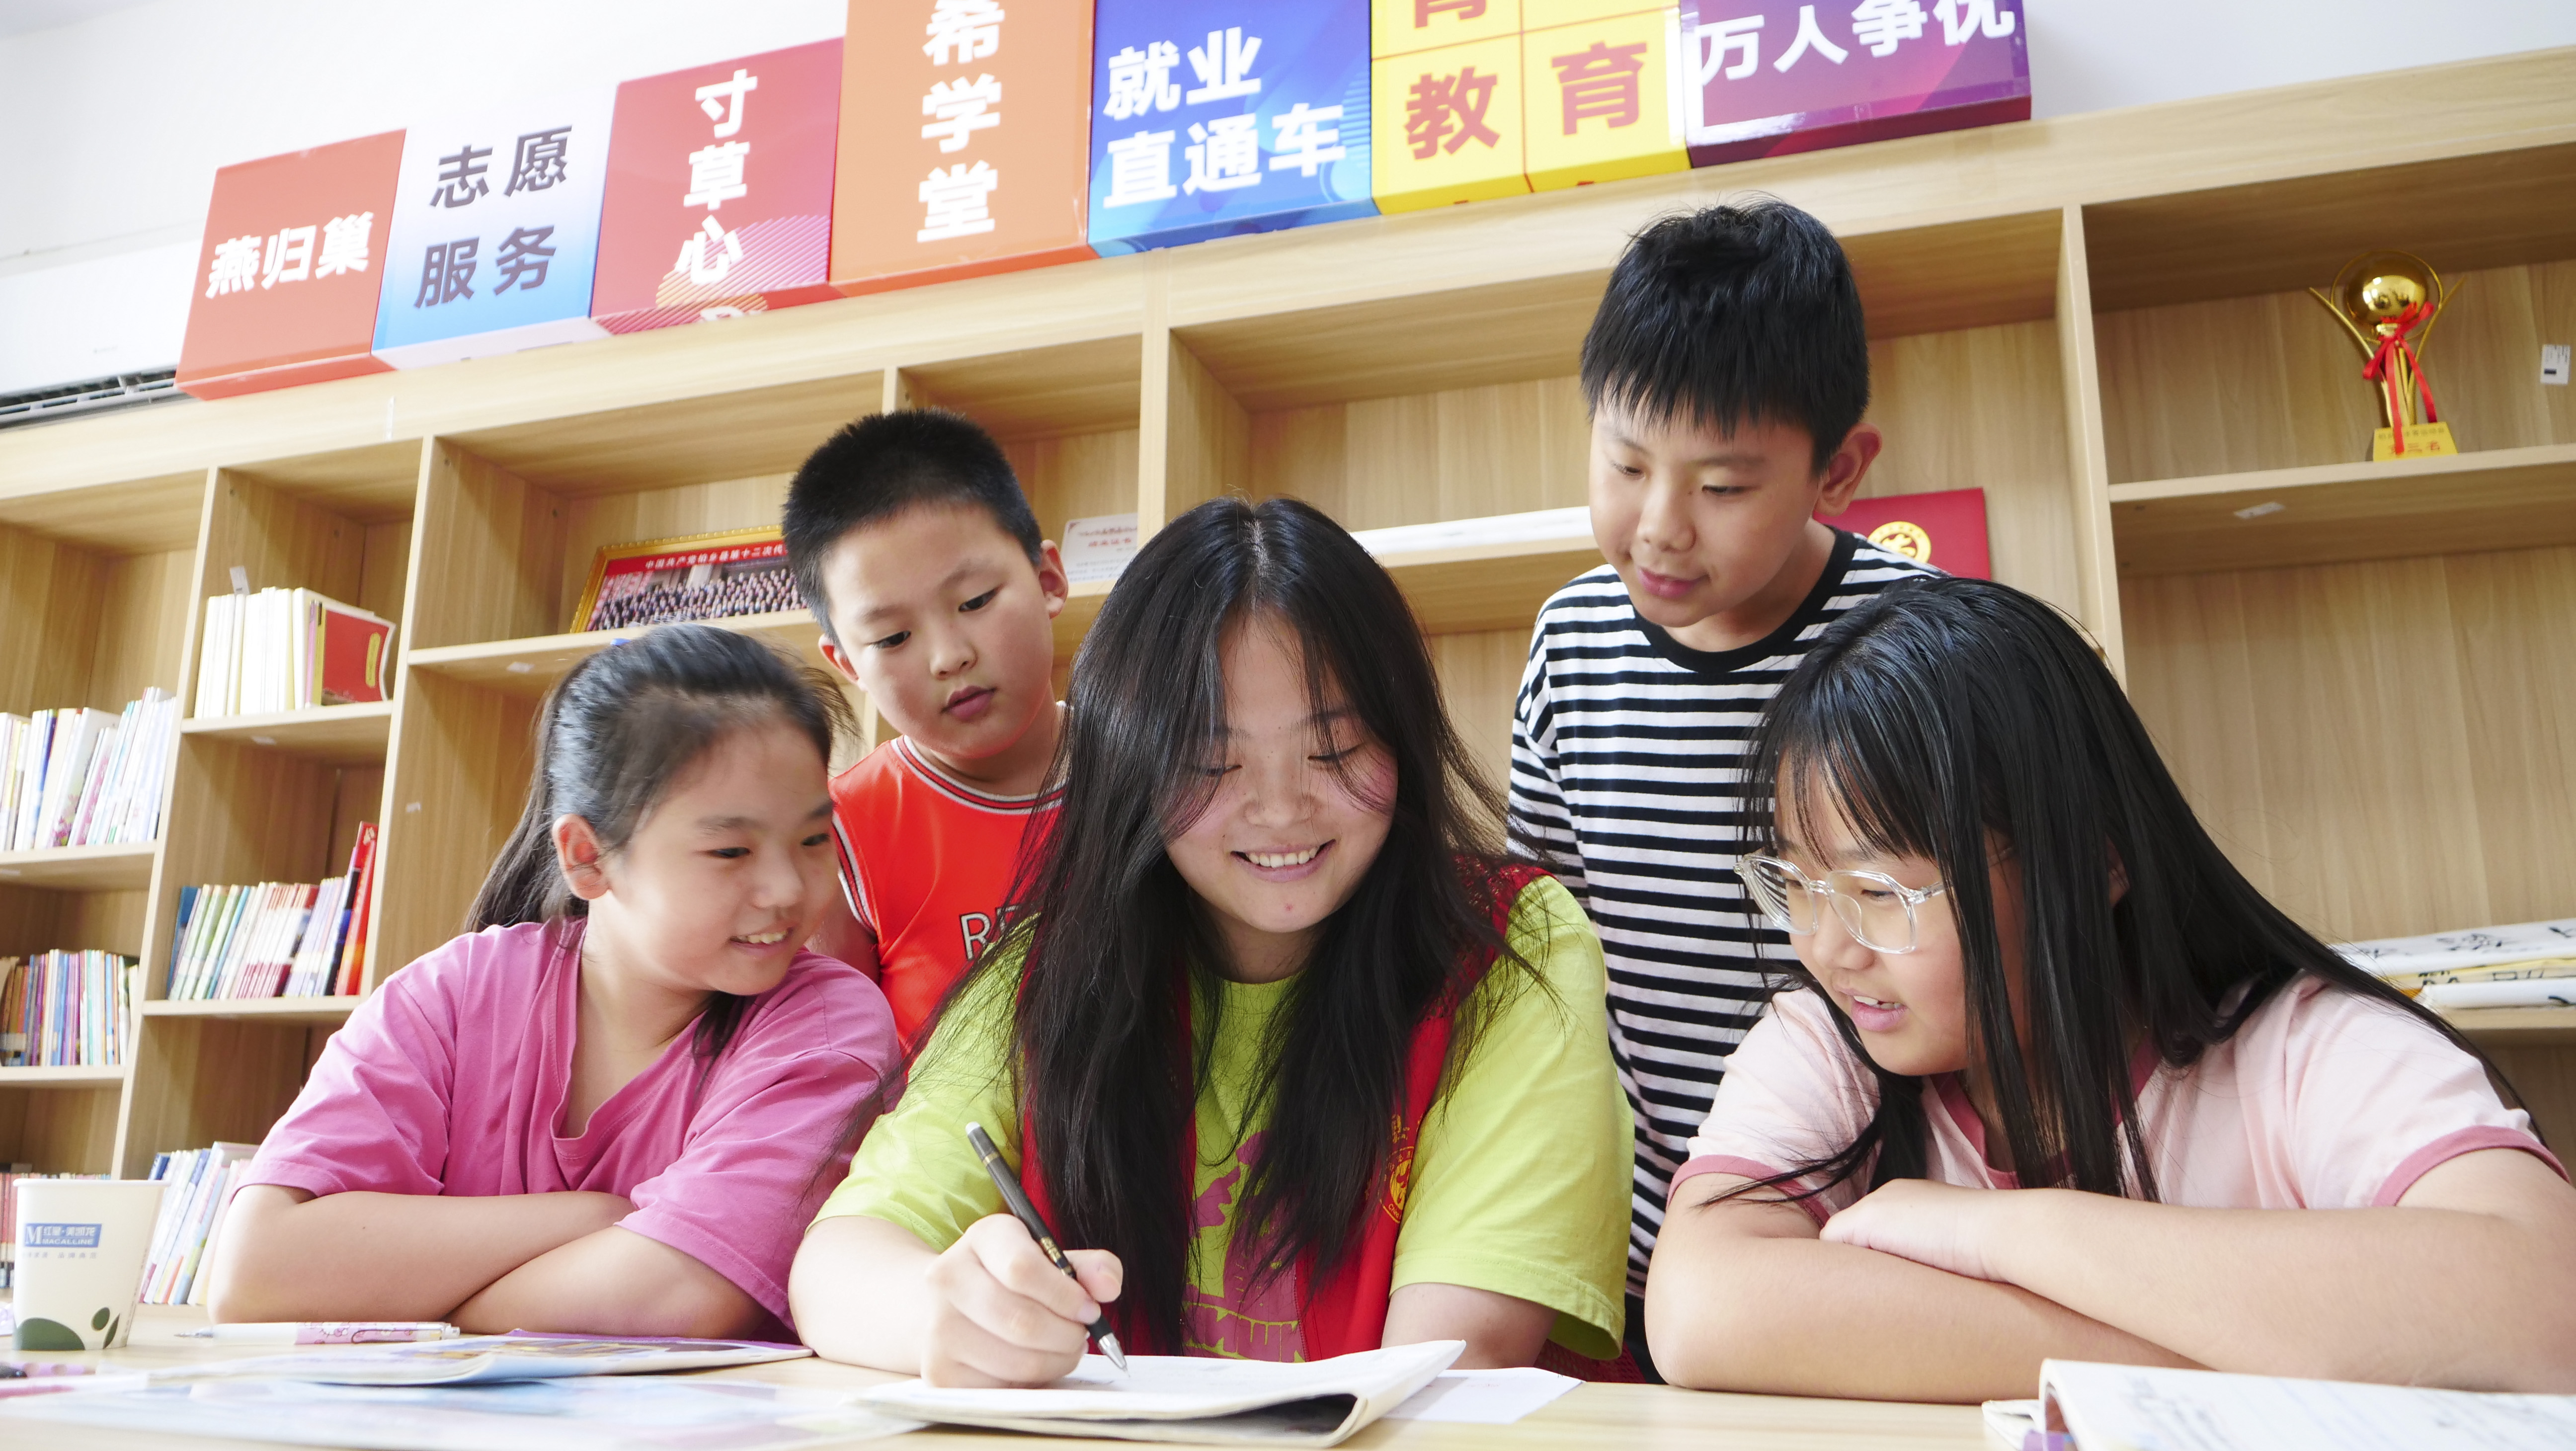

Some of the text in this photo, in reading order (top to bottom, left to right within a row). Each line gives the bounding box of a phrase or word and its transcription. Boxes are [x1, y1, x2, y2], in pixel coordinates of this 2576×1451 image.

[917, 0, 1005, 242] 希学堂
[1103, 26, 1263, 121] 就业
[1404, 41, 1648, 161] 教育
[429, 125, 573, 209] 志愿
[674, 68, 761, 322] 寸草心
[1103, 102, 1347, 209] 直通车
[205, 210, 374, 299] 燕归巢
[413, 225, 557, 309] 服务
